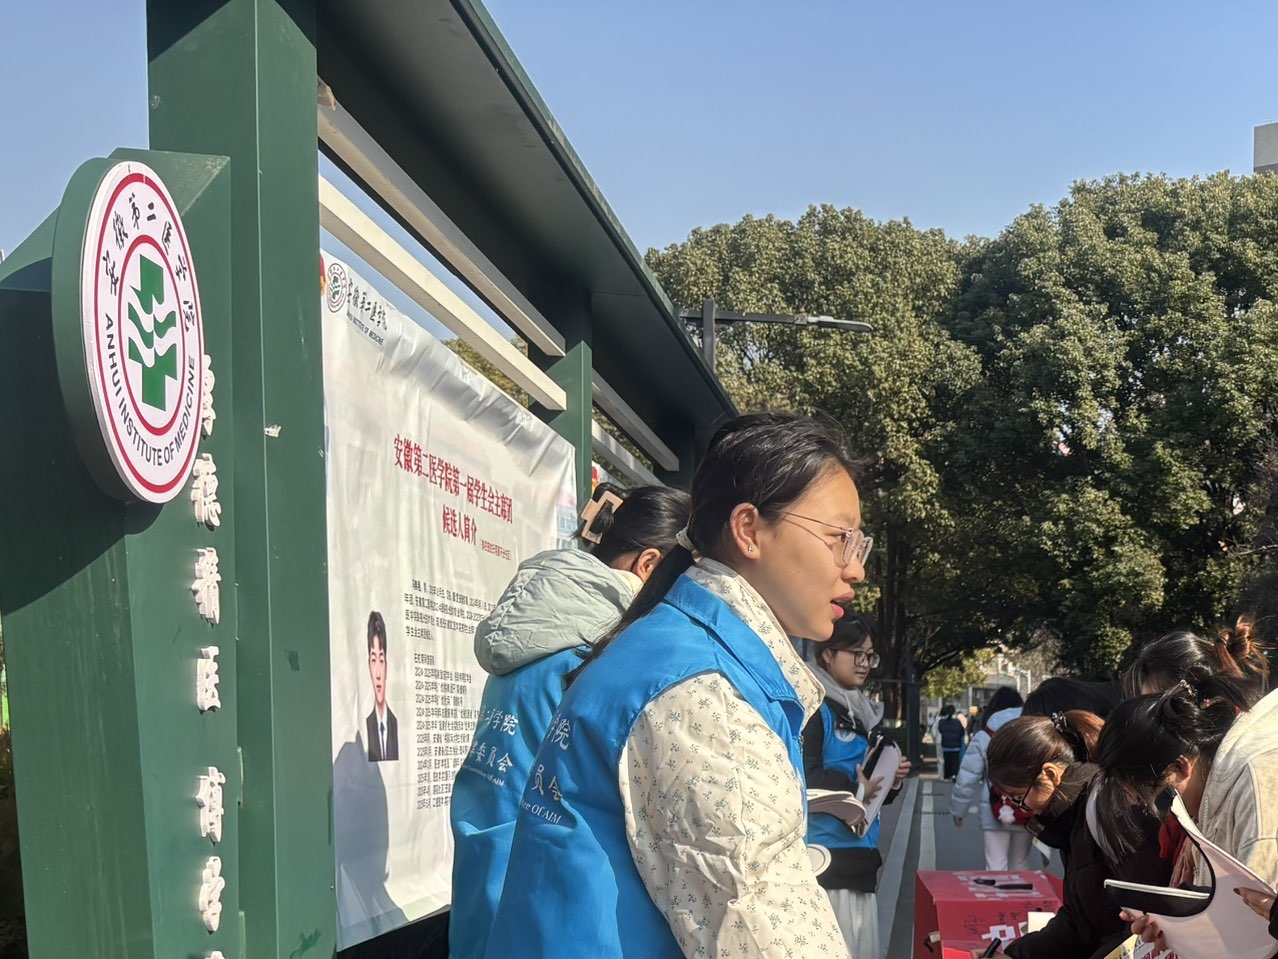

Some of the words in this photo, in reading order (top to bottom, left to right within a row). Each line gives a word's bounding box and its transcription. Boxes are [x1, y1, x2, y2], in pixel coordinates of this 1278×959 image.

[104, 312, 125, 398] ANHUI
[118, 396, 164, 467] INSTITUTE
[163, 447, 174, 464] OF
[174, 354, 196, 453] MEDICINE
[393, 433, 513, 524] 安徽第二医学院第一届学生会主席团
[442, 504, 478, 546] 候选人简介
[531, 803, 544, 818] Of
[543, 808, 563, 825] AIM
